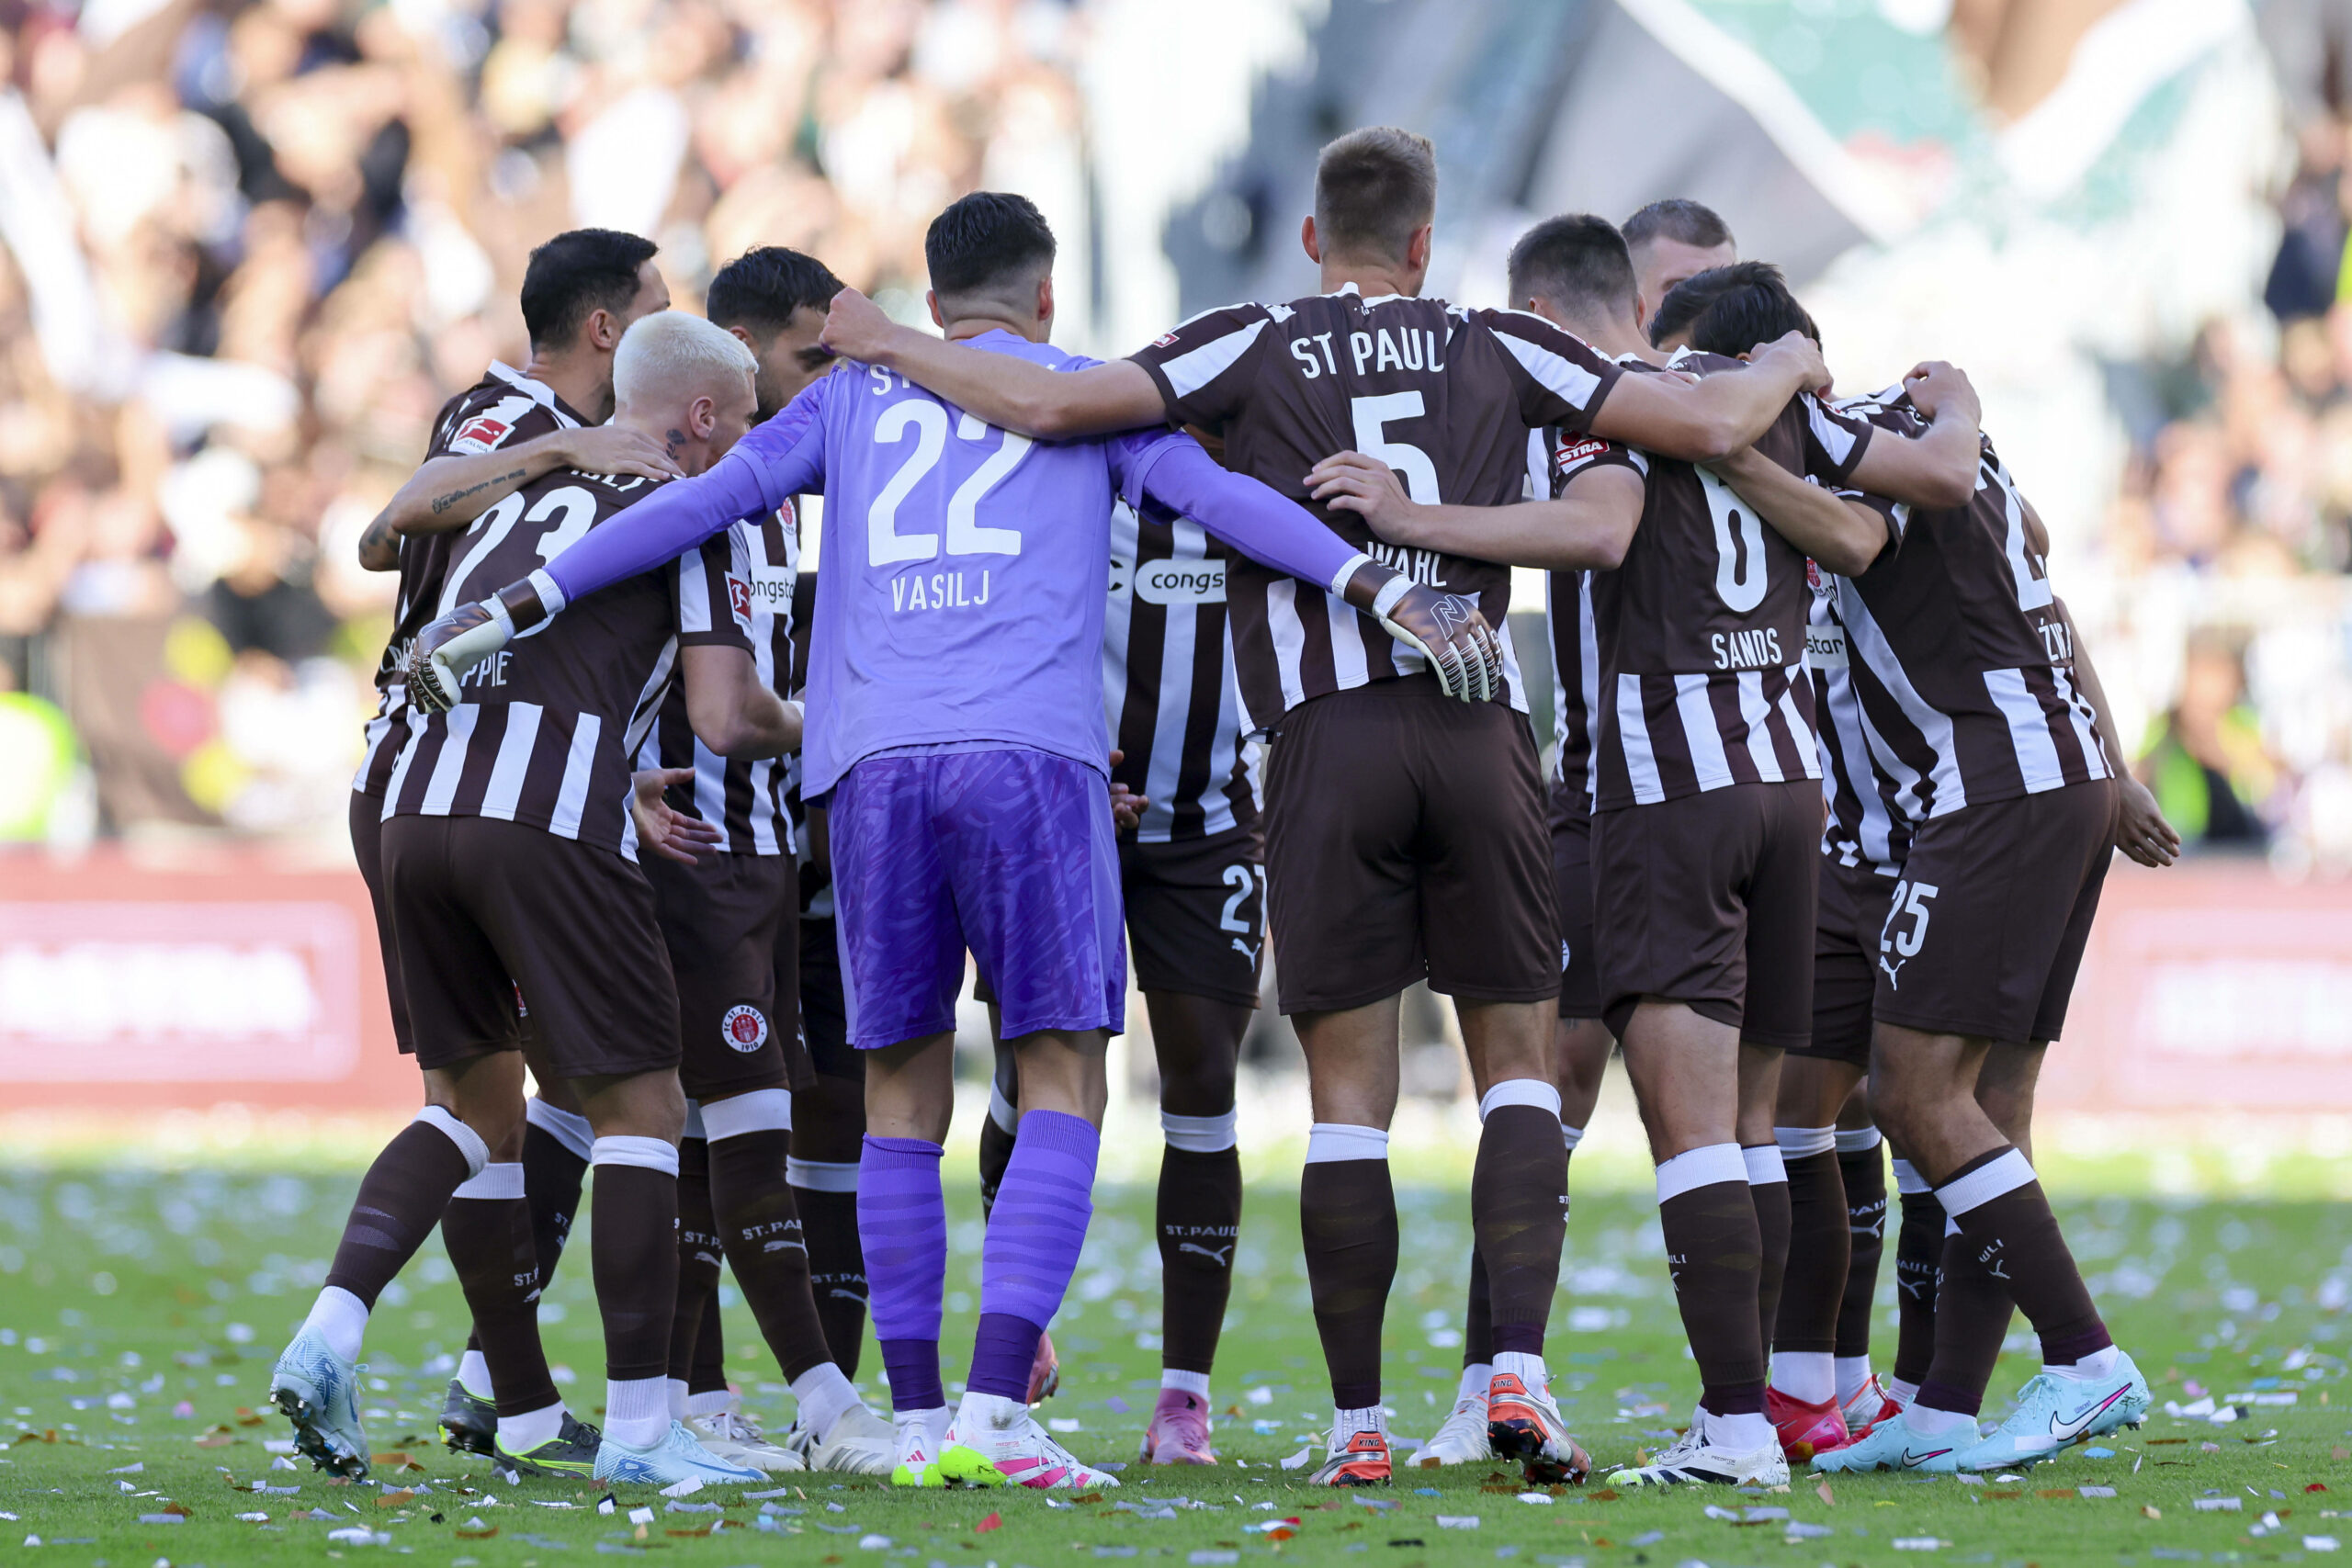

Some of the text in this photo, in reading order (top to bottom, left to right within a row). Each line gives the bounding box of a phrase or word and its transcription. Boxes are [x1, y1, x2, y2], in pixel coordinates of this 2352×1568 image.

[1290, 331, 1337, 378] ST
[1351, 390, 1442, 505] 5
[1557, 442, 1604, 463] STRA
[867, 399, 1034, 567] 22
[1693, 462, 1768, 613] 6
[435, 486, 597, 639] 23
[1151, 572, 1224, 594] congs
[1367, 541, 1447, 587] WAHL
[891, 570, 989, 612] VASILJ
[1712, 627, 1782, 670] SANDS
[1807, 634, 1843, 654] star
[1880, 879, 1939, 957] 25
[1493, 1379, 1513, 1388] KING
[1358, 1438, 1380, 1447] KING
